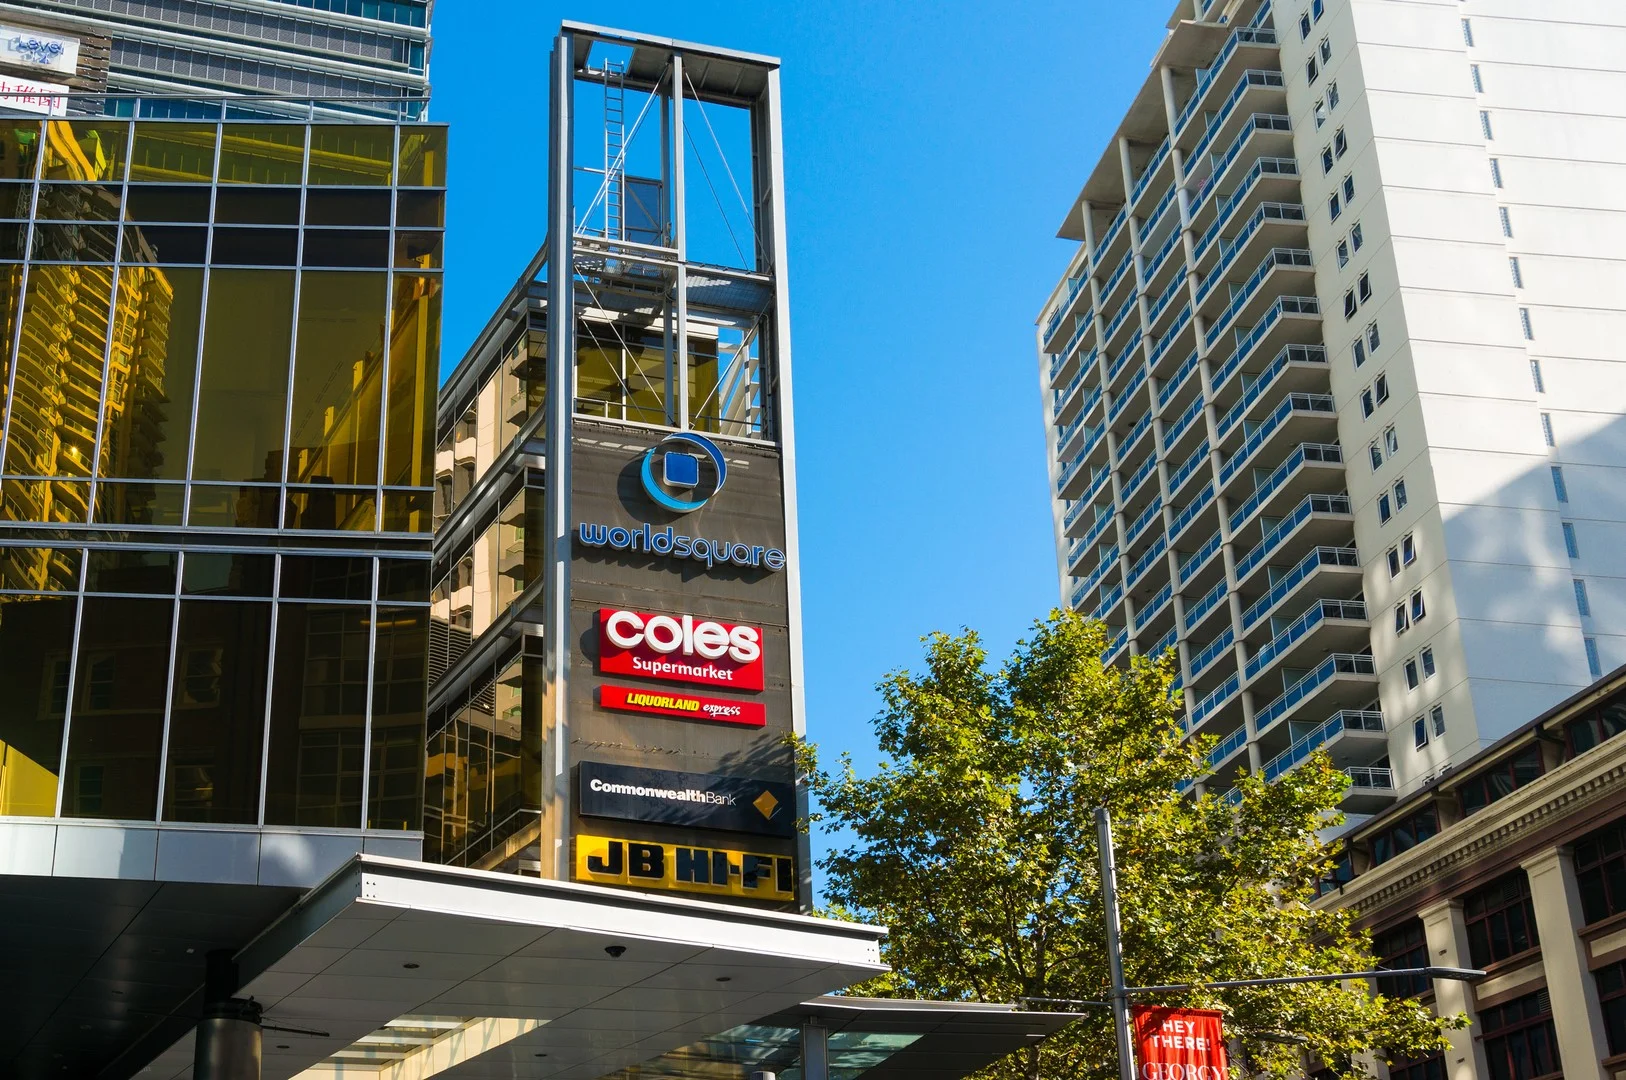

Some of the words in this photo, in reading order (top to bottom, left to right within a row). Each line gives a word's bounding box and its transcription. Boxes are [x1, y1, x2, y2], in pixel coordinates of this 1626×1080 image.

[580, 523, 786, 571] worldsquare
[606, 611, 761, 664] coles
[632, 656, 733, 681] Supermarket
[627, 692, 700, 712] LIQUORLAND
[702, 703, 741, 718] express
[590, 779, 737, 806] CommonwealthBank
[587, 841, 665, 880] JB
[675, 846, 793, 893] HI-FI
[1162, 1020, 1196, 1034] HEY
[1151, 1034, 1211, 1051] THERE!
